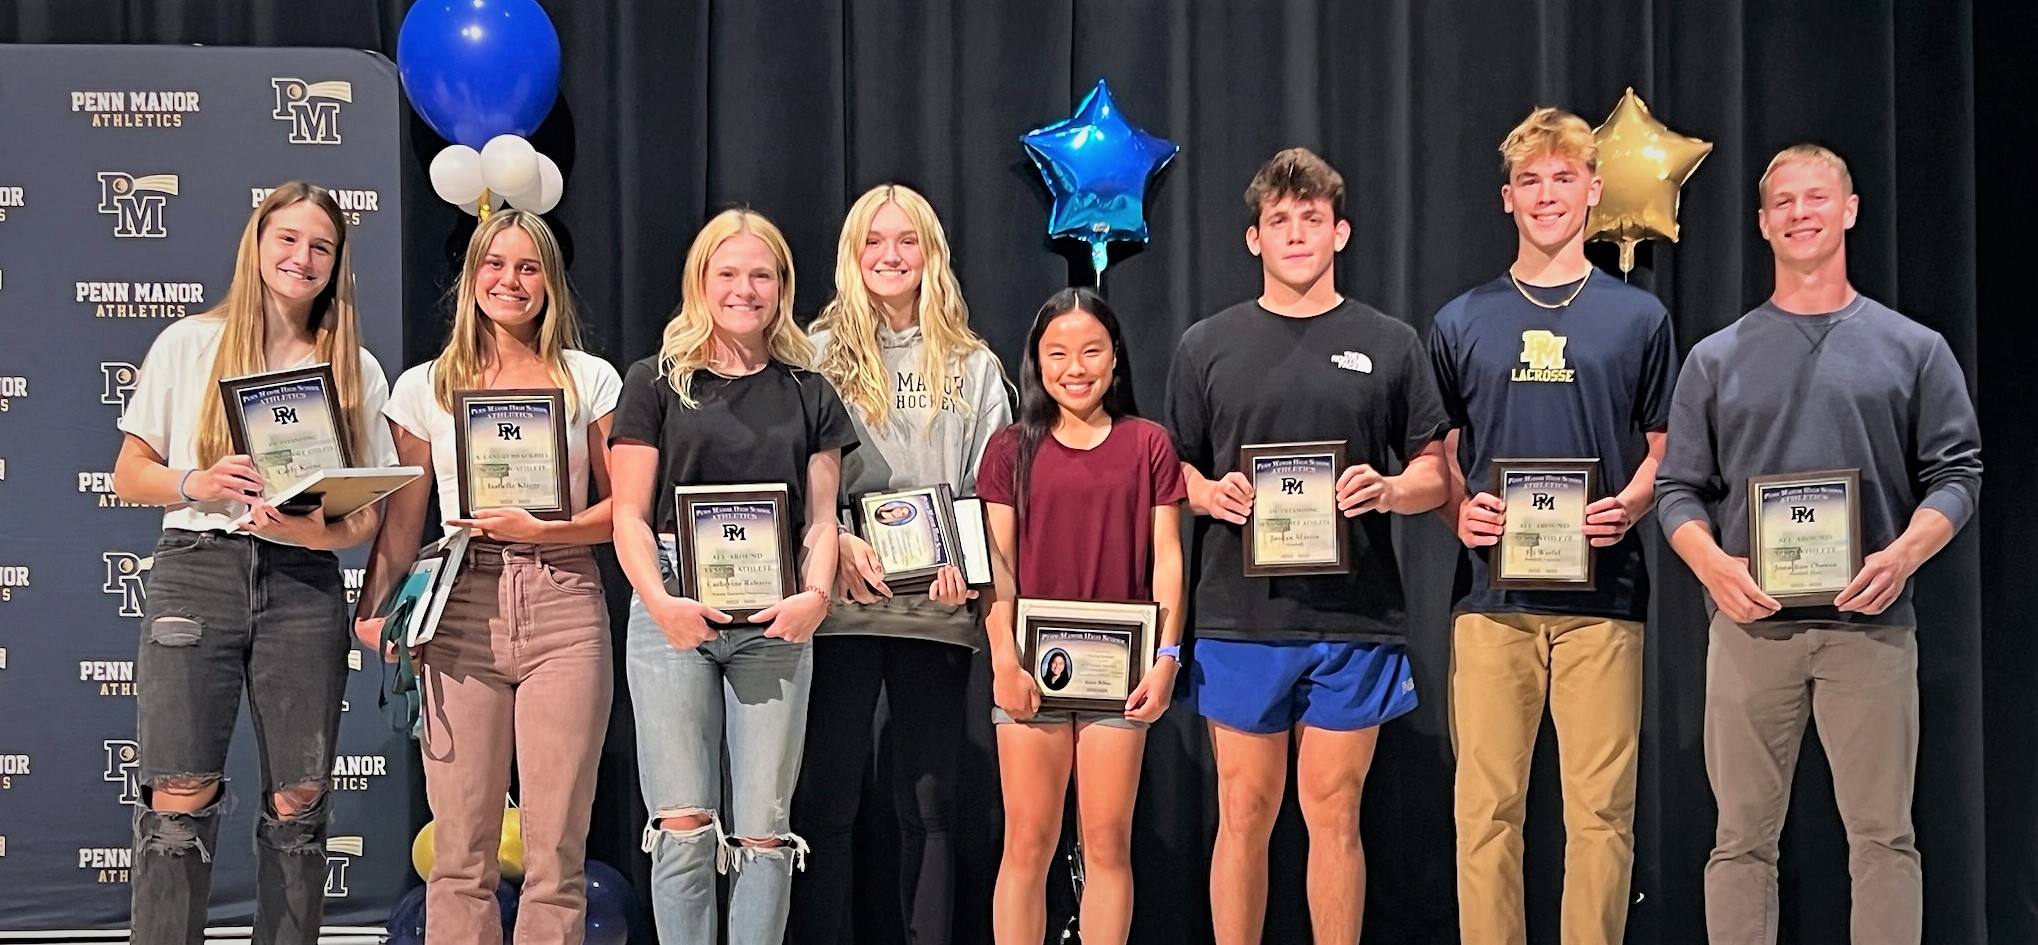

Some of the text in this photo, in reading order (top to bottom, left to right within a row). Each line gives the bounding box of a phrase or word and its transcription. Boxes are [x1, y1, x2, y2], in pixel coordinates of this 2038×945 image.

[71, 91, 200, 112] PENN MANOR
[92, 113, 182, 128] ATHLETICS
[75, 282, 204, 303] PENN MANOR
[96, 304, 186, 318] ATHLETICS
[897, 371, 964, 398] MAOR
[1511, 369, 1575, 383] LACROSSE
[272, 406, 299, 425] PM
[497, 423, 521, 440] PM
[78, 472, 115, 493] PEN
[1281, 477, 1304, 495] PM
[1532, 493, 1555, 510] PM
[1791, 506, 1815, 523] PM
[722, 524, 746, 541] PM
[80, 661, 133, 681] PENN
[331, 755, 387, 776] ANOR
[79, 848, 132, 868] PENN
